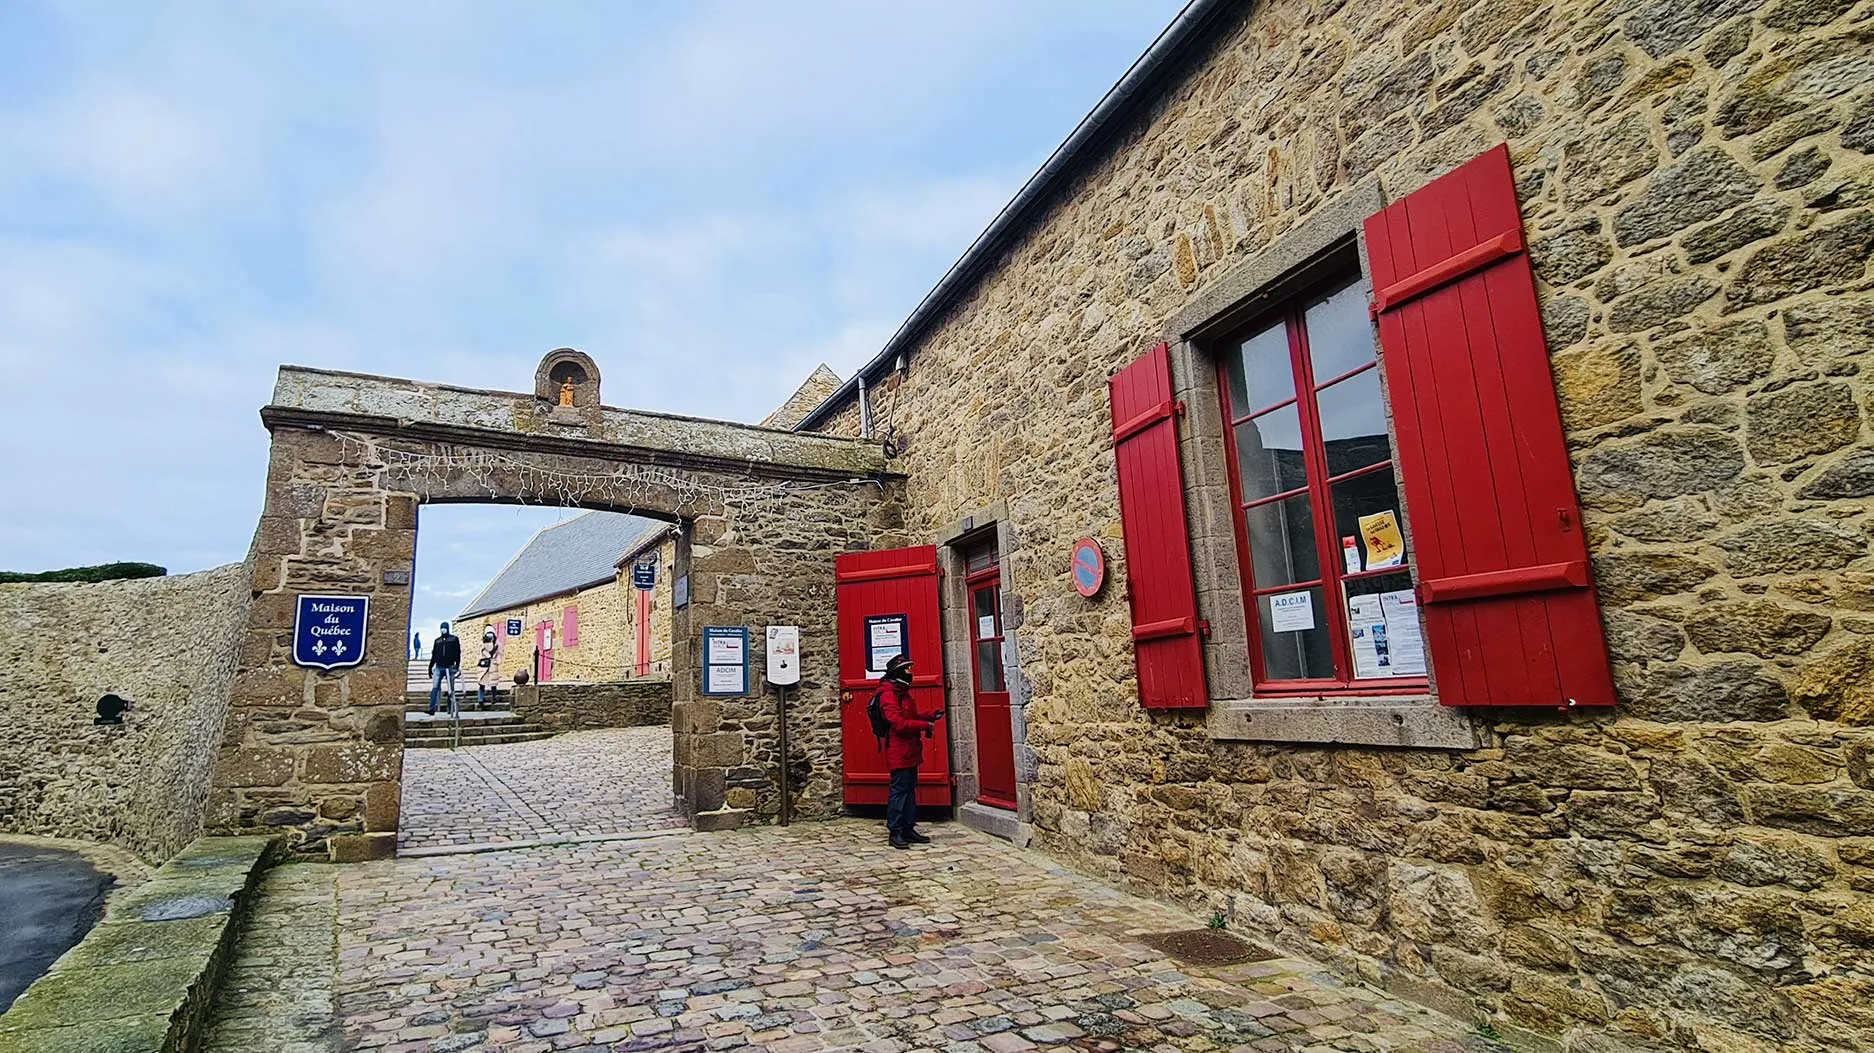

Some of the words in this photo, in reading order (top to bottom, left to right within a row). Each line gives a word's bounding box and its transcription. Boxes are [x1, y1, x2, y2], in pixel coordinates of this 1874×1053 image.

[311, 603, 355, 613] Maison
[324, 613, 340, 624] du
[310, 625, 352, 637] Québec
